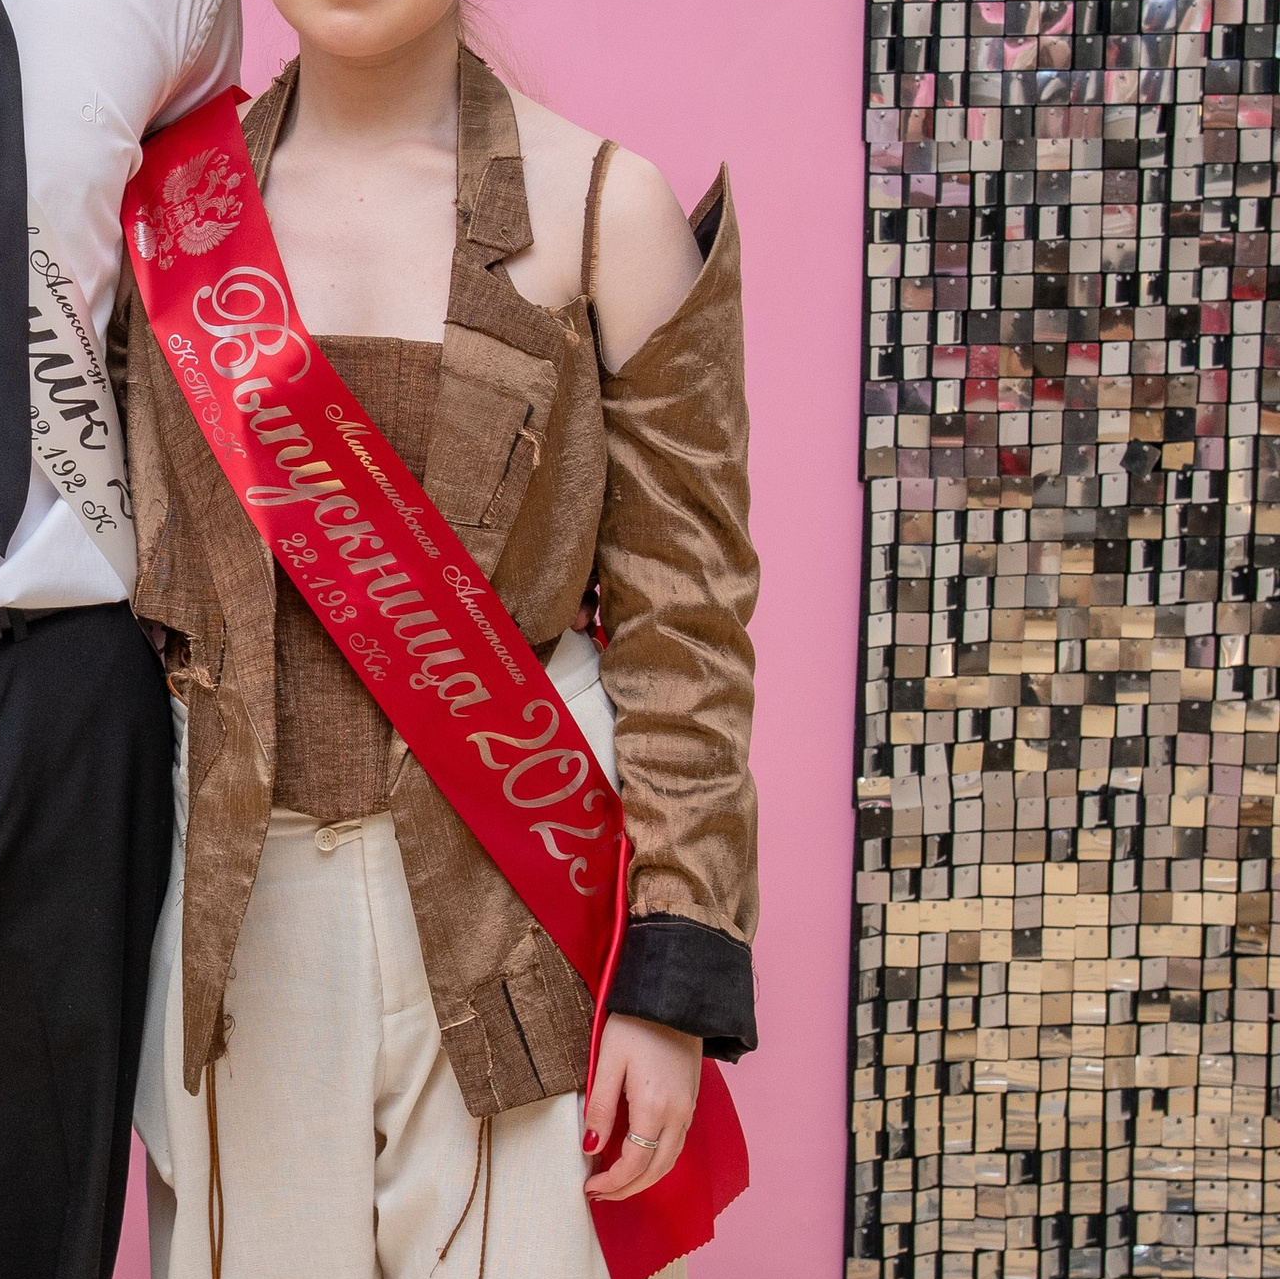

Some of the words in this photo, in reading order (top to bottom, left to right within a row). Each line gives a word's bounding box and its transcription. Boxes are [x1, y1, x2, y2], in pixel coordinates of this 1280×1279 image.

[30, 249, 108, 393] Александр
[167, 333, 248, 460] КТЭК
[276, 532, 358, 624] 22.193
[192, 265, 493, 718] Выпускница
[324, 403, 442, 560] Миклашевская
[442, 564, 528, 686] Анастасия
